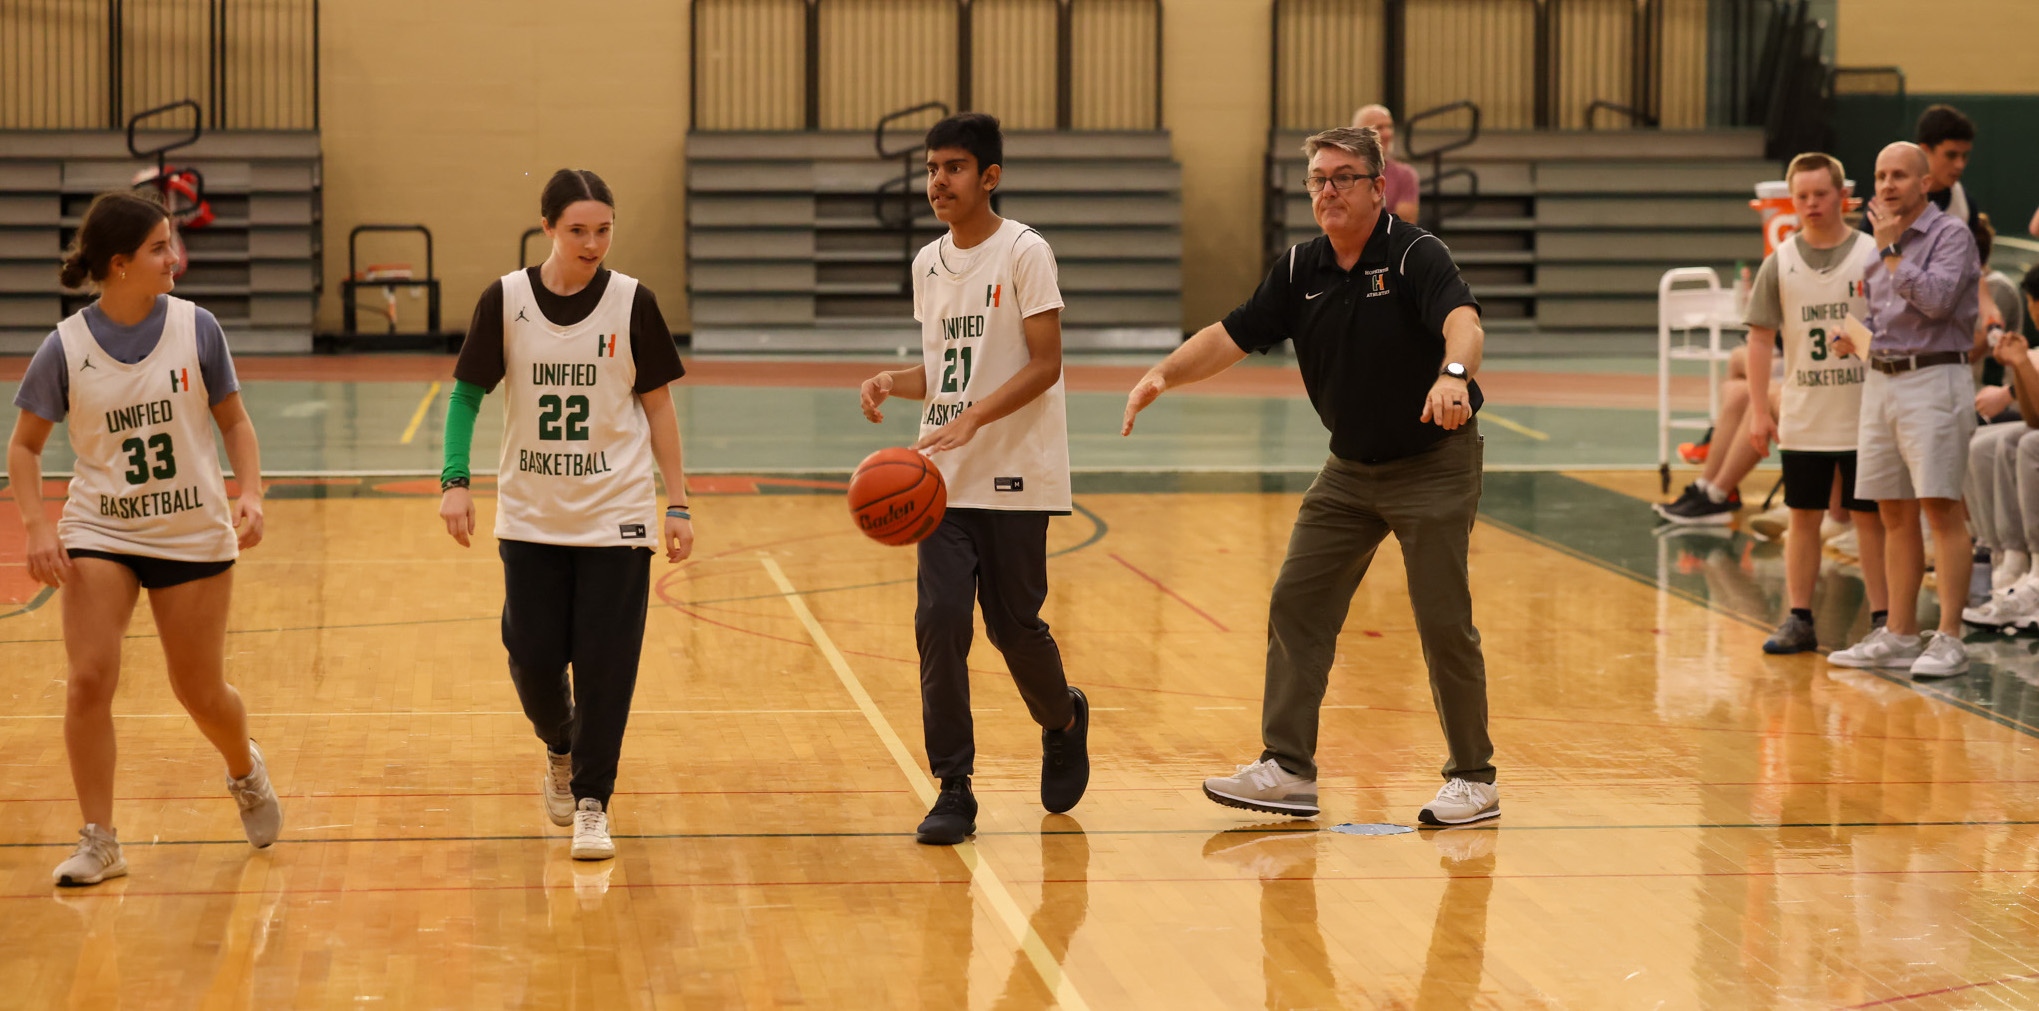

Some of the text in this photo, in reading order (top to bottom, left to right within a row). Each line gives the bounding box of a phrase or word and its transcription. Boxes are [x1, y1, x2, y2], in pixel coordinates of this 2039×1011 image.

[1802, 303, 1848, 322] UNIFIED
[532, 363, 597, 387] UNIFIED
[941, 346, 972, 393] 21
[106, 400, 173, 434] UNIFIED
[538, 394, 589, 441] 22
[122, 432, 177, 485] 33
[519, 449, 612, 477] BASKETBALL
[100, 486, 204, 519] BASKETBALL
[860, 500, 915, 530] Baden
